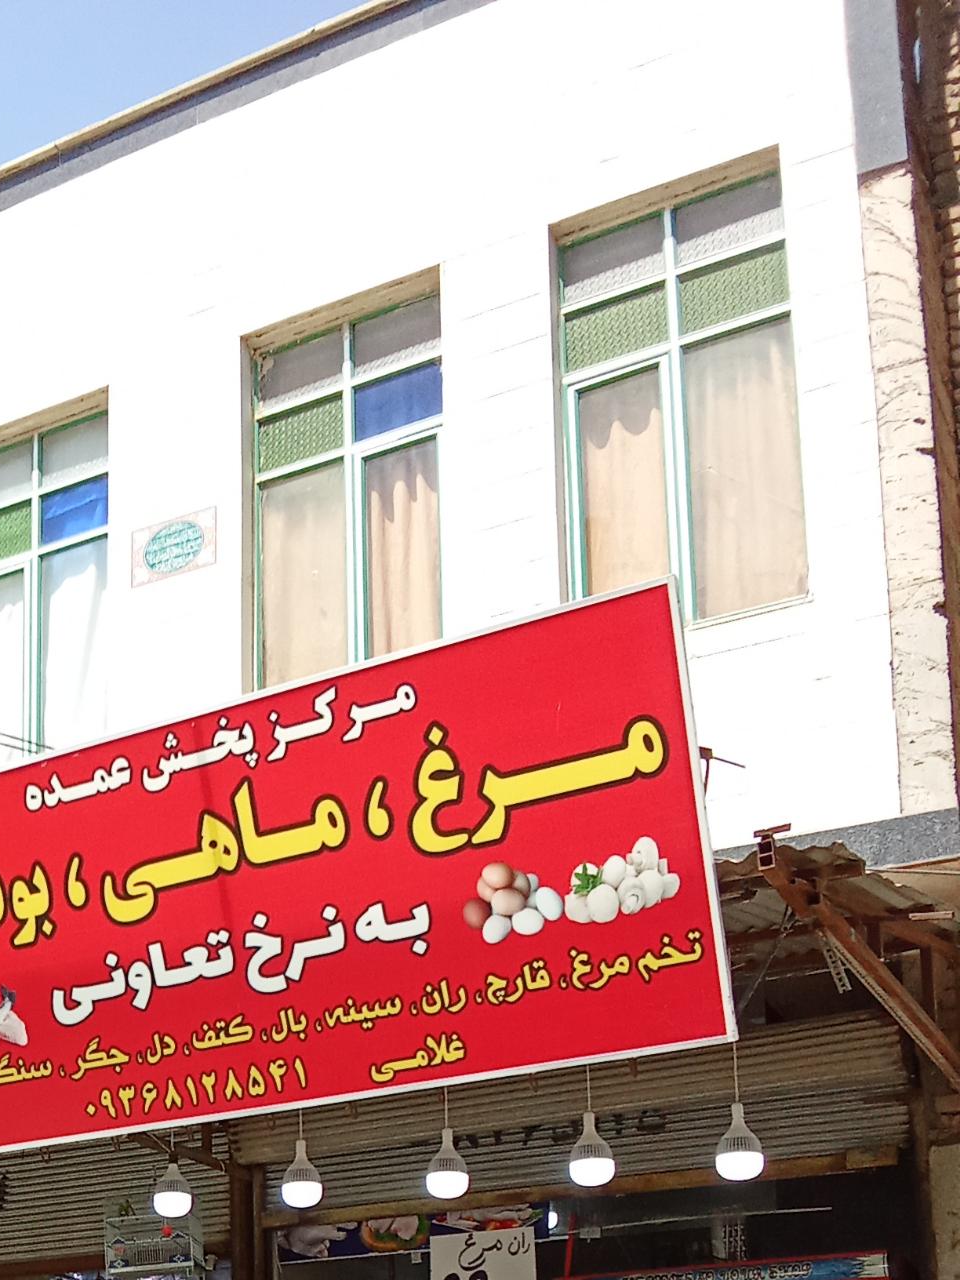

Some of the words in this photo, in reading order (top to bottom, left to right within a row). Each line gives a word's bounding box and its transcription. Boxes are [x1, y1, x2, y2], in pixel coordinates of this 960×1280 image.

[266, 682, 417, 762] مرکز
[25, 755, 131, 812] عمده
[142, 716, 255, 793] پخش
[408, 715, 669, 858] مرغ
[100, 776, 348, 924] ماهی
[242, 903, 346, 994] نرخ
[355, 901, 431, 957] به
[636, 929, 703, 981] تخم
[51, 928, 235, 1026] تعاونی
[85, 1057, 308, 1119] ۰۹۳۶۸۱۲۸۵۴۱
[370, 1032, 467, 1083] غلامی
[458, 1233, 502, 1271] مرغ
[508, 1232, 530, 1256] ران
